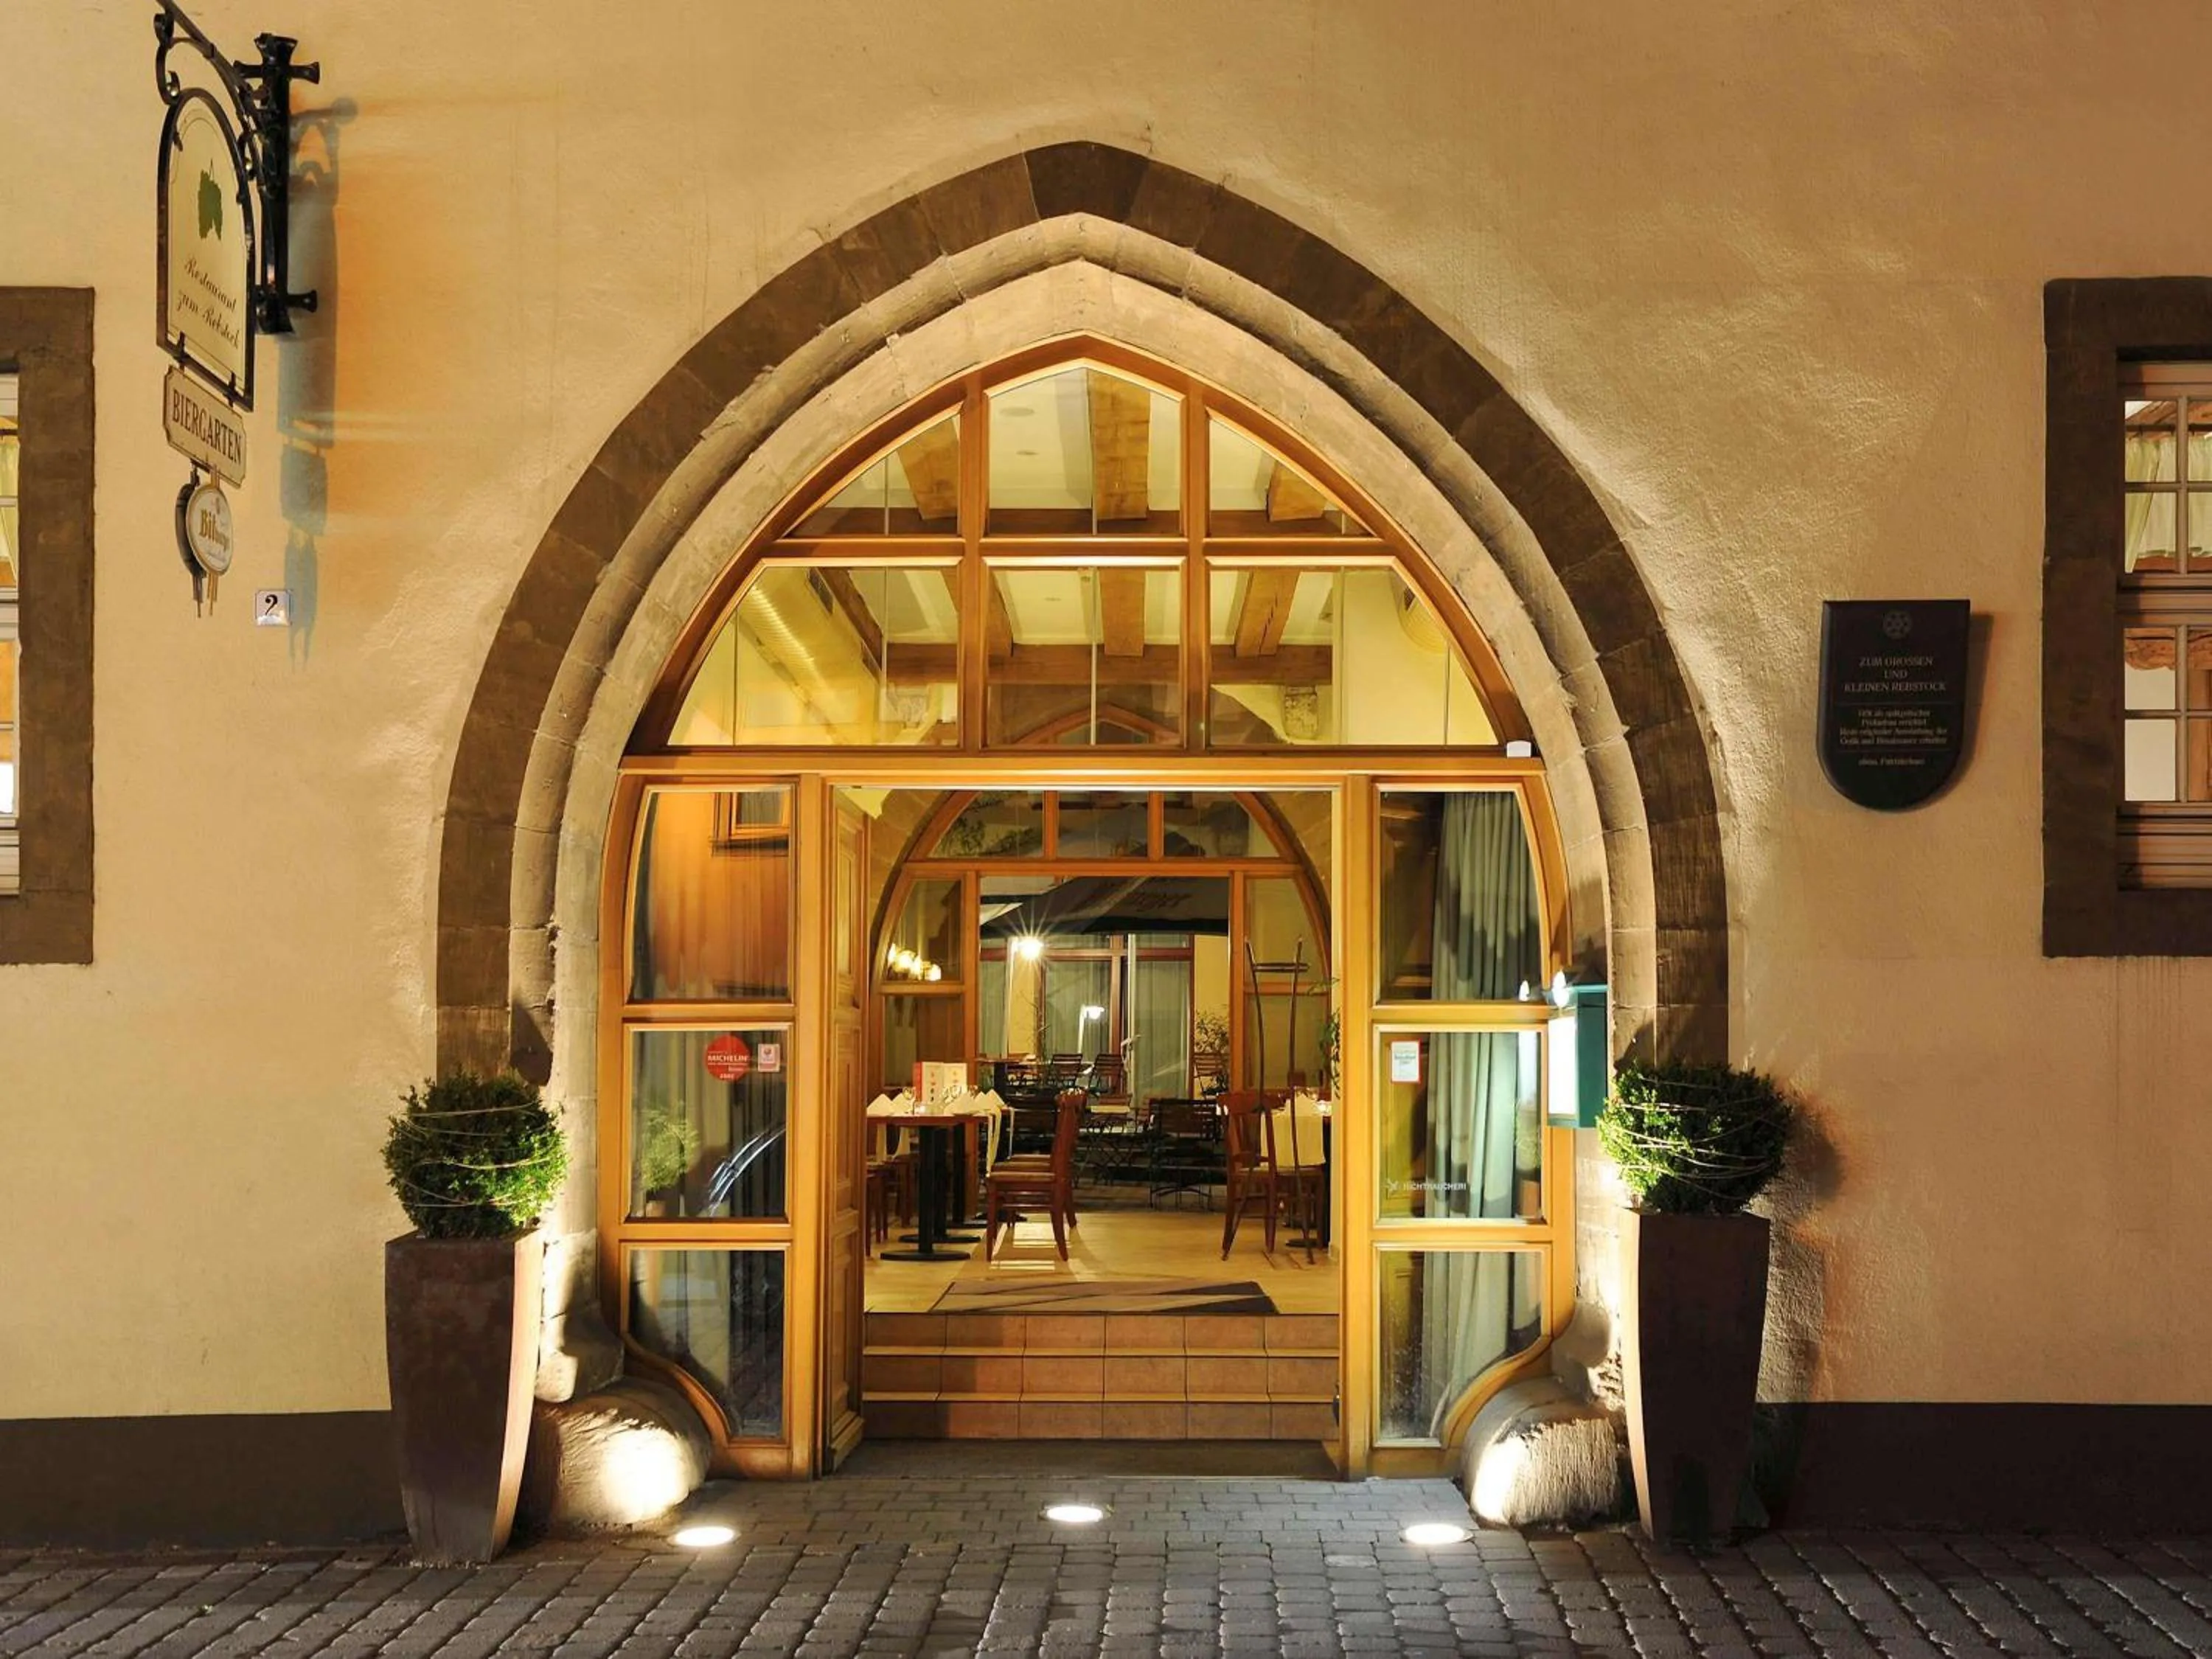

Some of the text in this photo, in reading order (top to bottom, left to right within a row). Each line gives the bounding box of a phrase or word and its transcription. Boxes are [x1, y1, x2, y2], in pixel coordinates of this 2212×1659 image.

[184, 258, 237, 313] Restaurant
[172, 389, 242, 465] BIERGARTEN
[1859, 656, 1933, 667] ZUM GROSSEN
[1884, 669, 1908, 679] UND
[1844, 681, 1947, 692] KLEINEN REBSTOCK
